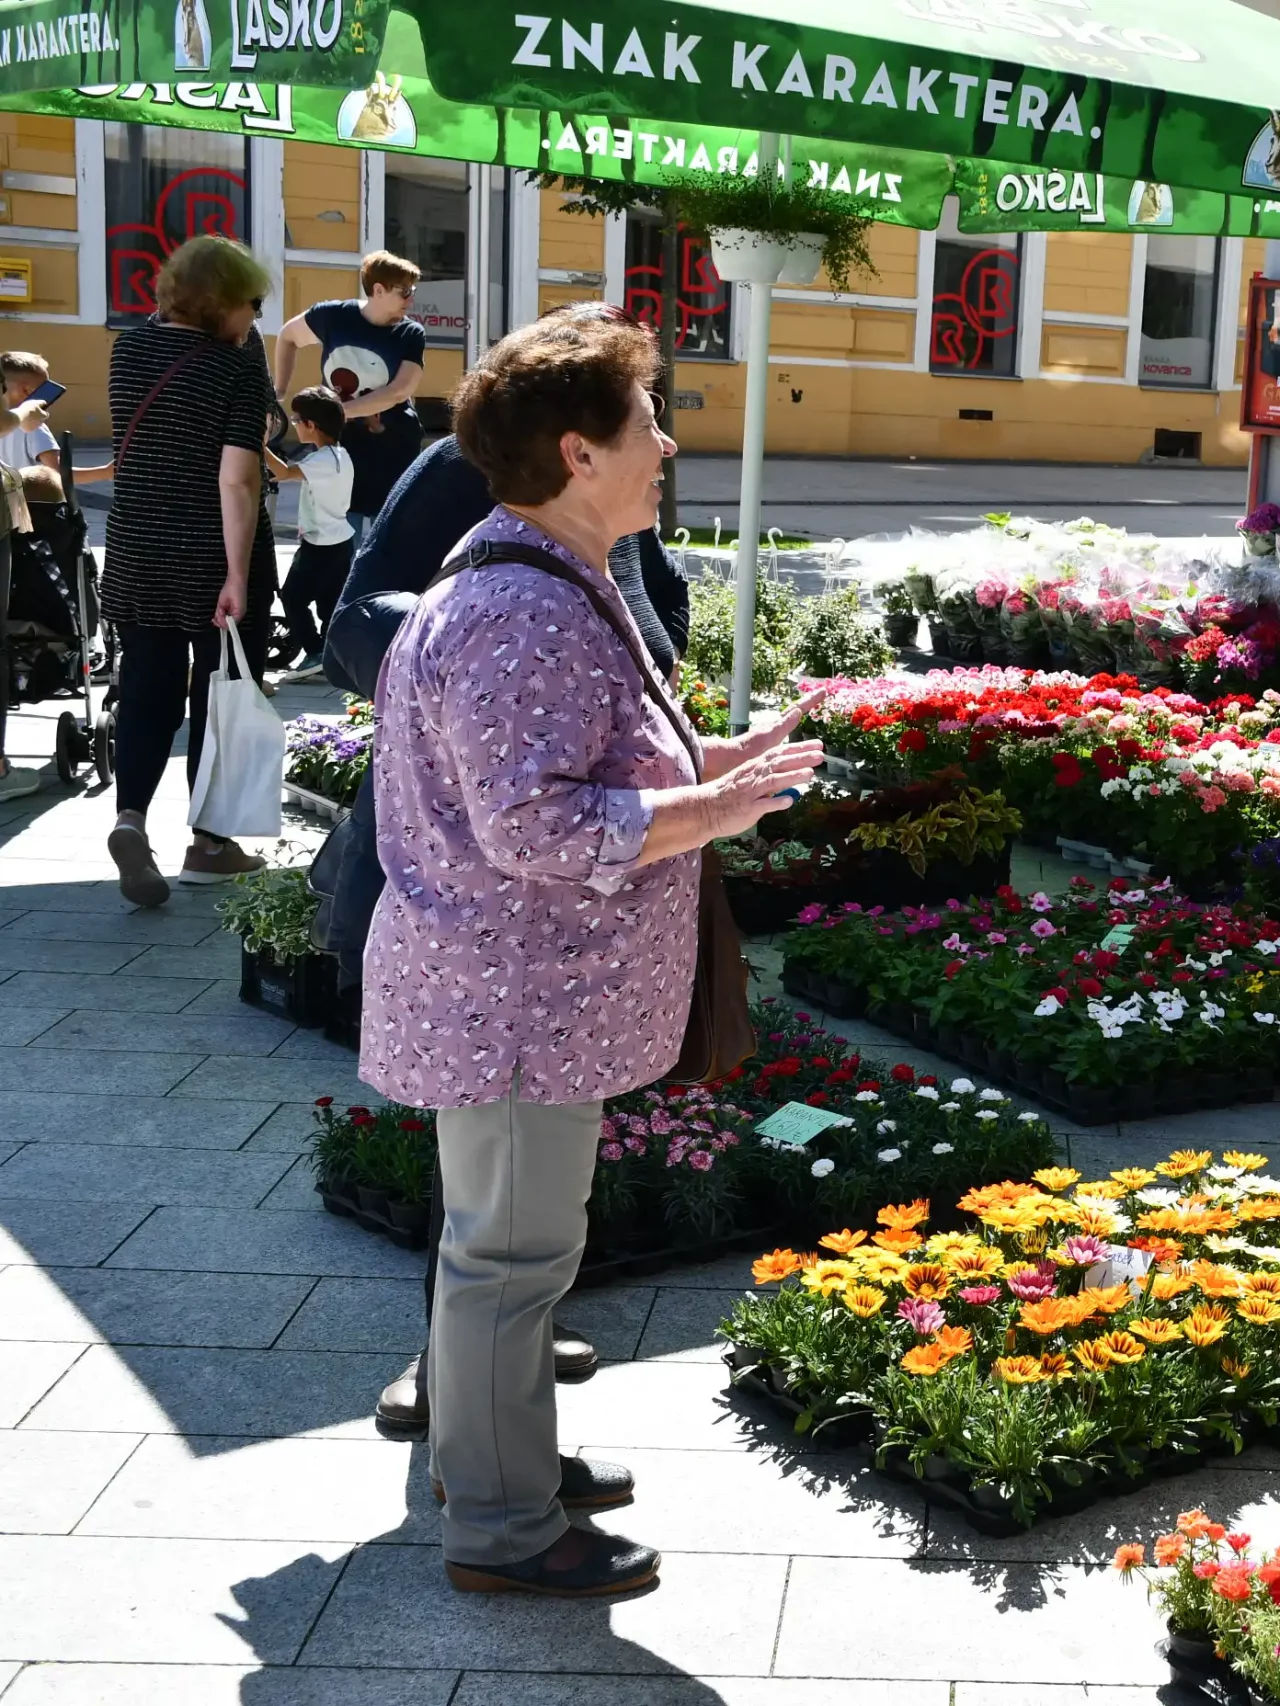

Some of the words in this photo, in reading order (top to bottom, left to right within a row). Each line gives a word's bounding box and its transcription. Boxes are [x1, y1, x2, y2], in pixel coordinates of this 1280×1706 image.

[16, 10, 120, 63] KARAKTERA.
[512, 14, 702, 84] ZNAK
[732, 41, 1102, 140] KARAKTERA.
